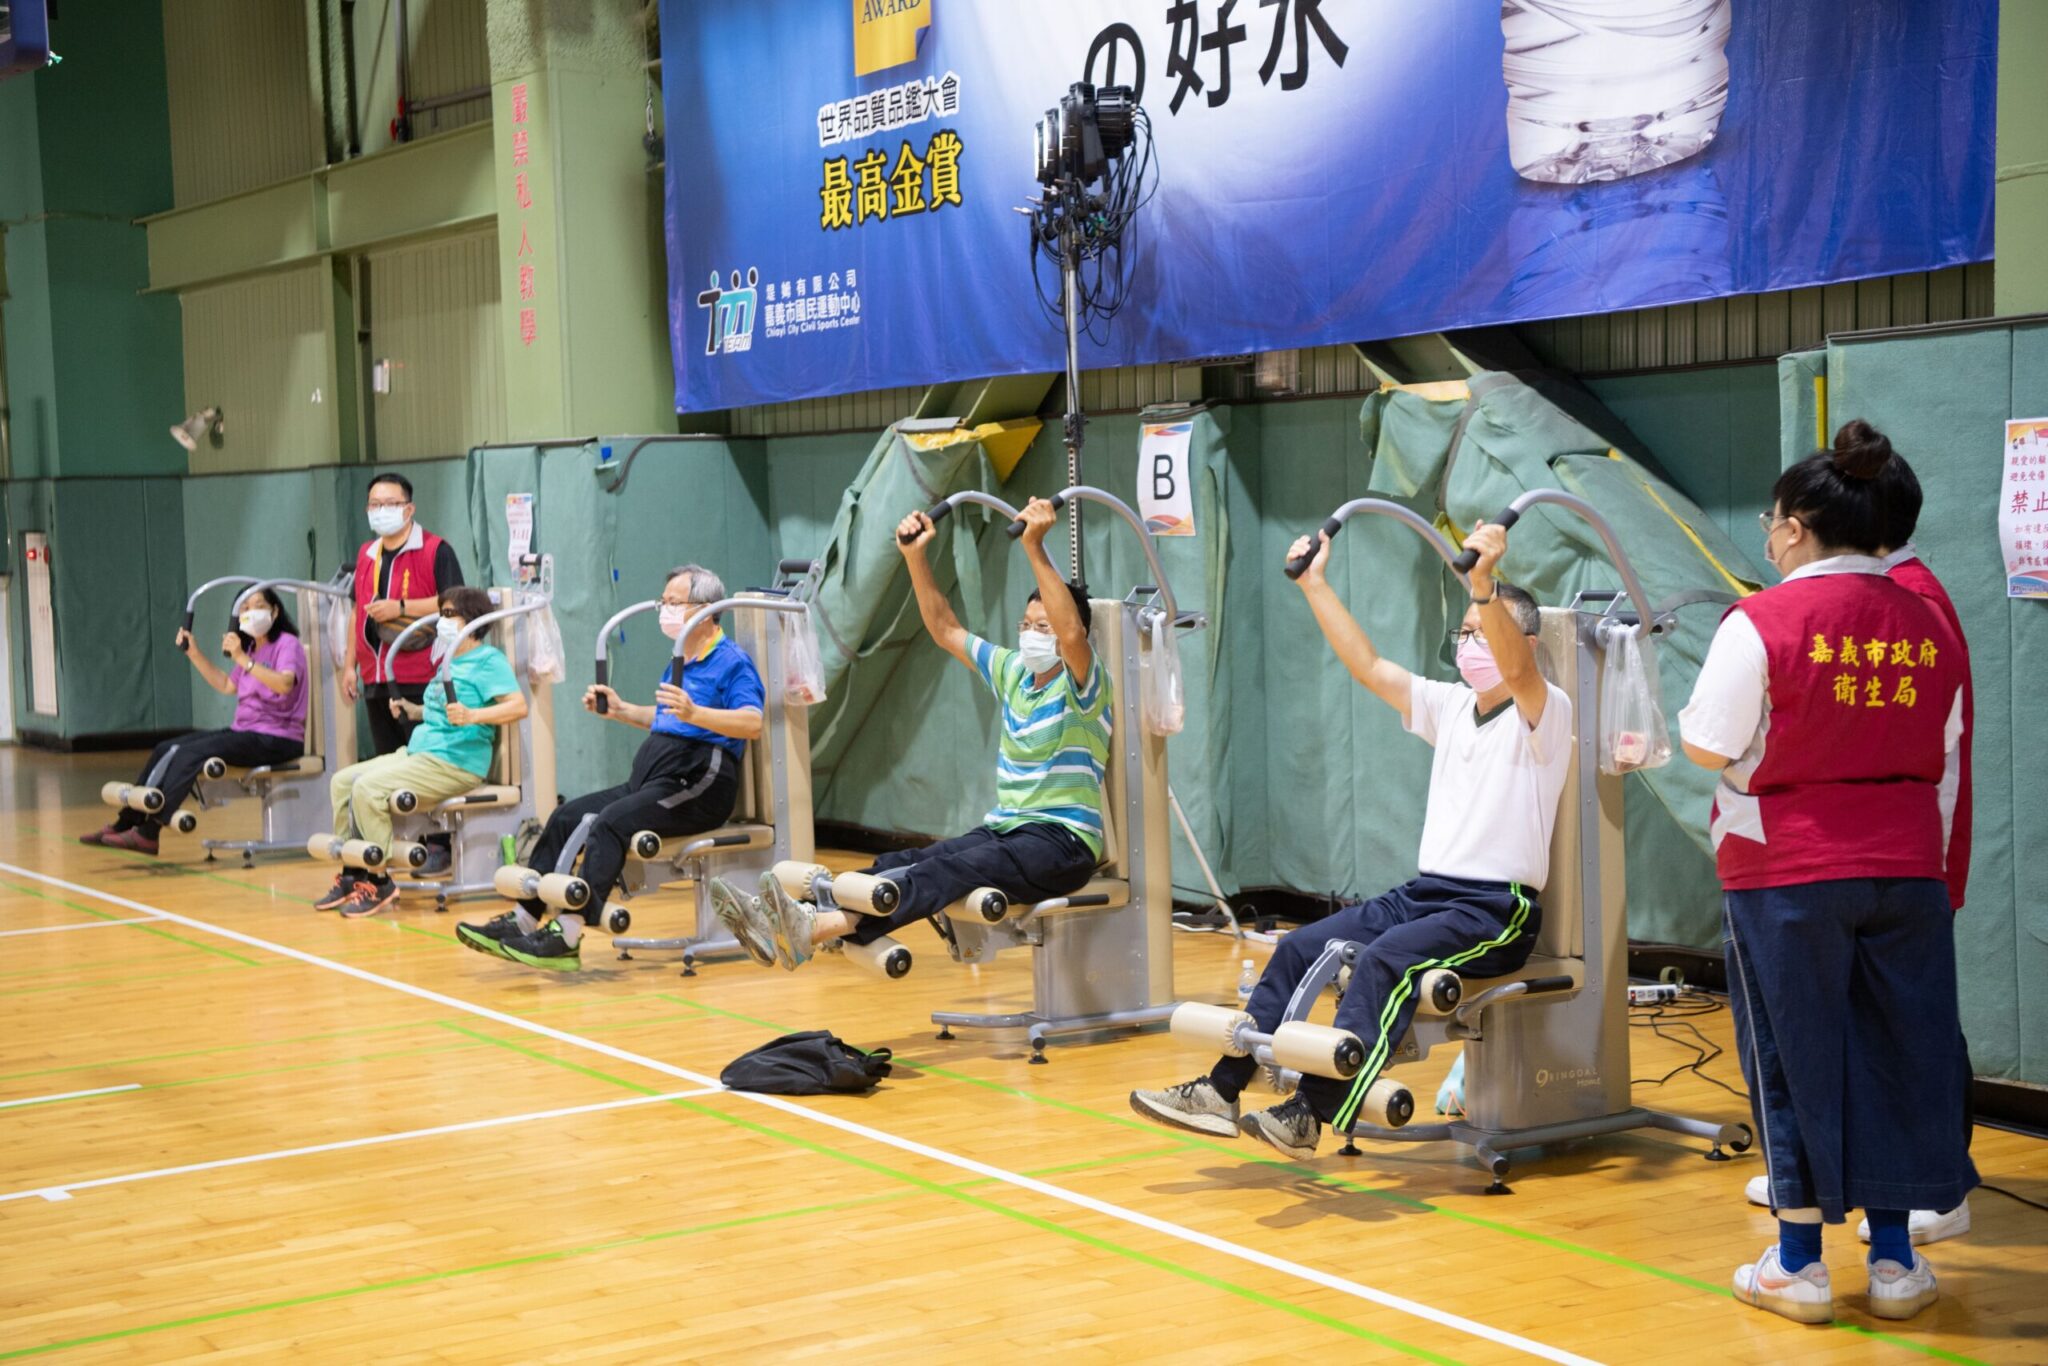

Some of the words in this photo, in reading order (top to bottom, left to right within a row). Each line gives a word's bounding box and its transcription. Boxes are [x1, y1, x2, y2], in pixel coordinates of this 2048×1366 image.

[820, 74, 958, 143] 世界品質品鑑大會
[819, 132, 963, 229] 最高金賞
[512, 83, 539, 347] 嚴禁私人教學
[764, 291, 861, 327] 嘉義市國民運動中心
[766, 326, 786, 338] Chiayi
[817, 319, 839, 332] Sports
[1154, 454, 1175, 500] B
[2011, 490, 2048, 515] 禁止
[1808, 633, 1938, 668] 嘉義市政府
[1832, 672, 1917, 707] 衛生局
